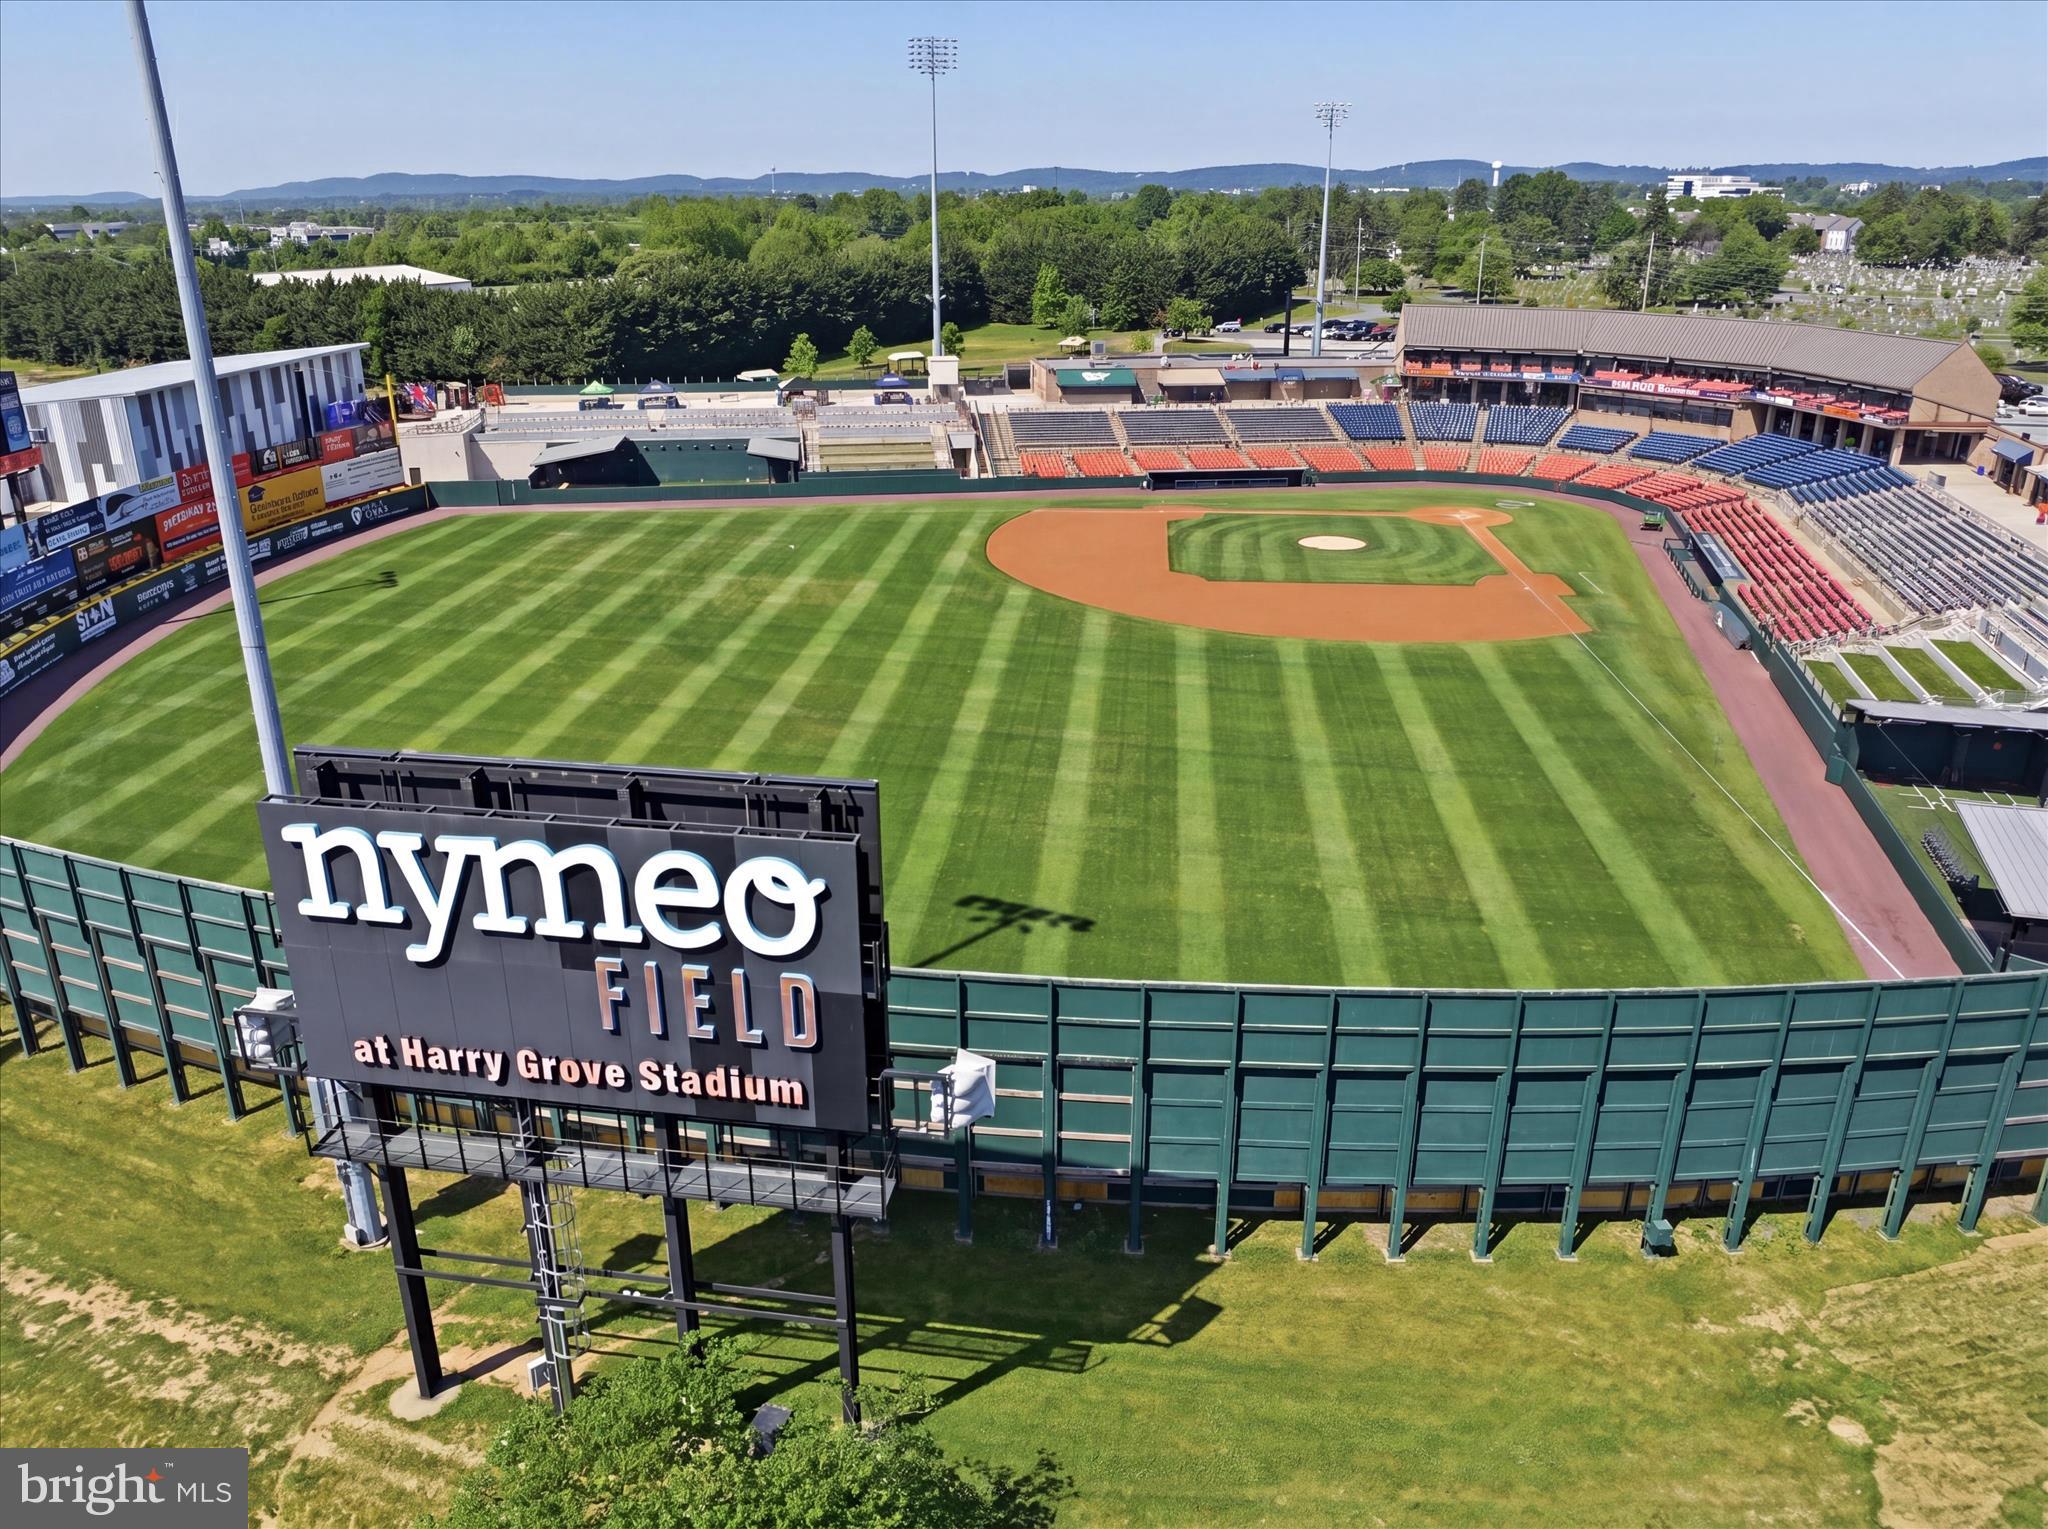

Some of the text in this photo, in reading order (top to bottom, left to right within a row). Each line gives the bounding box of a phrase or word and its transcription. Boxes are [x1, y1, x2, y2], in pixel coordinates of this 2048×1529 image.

[281, 823, 827, 963] nymeo
[594, 956, 818, 1049] FIELD
[353, 1035, 805, 1106] at Harry Grove Stadium
